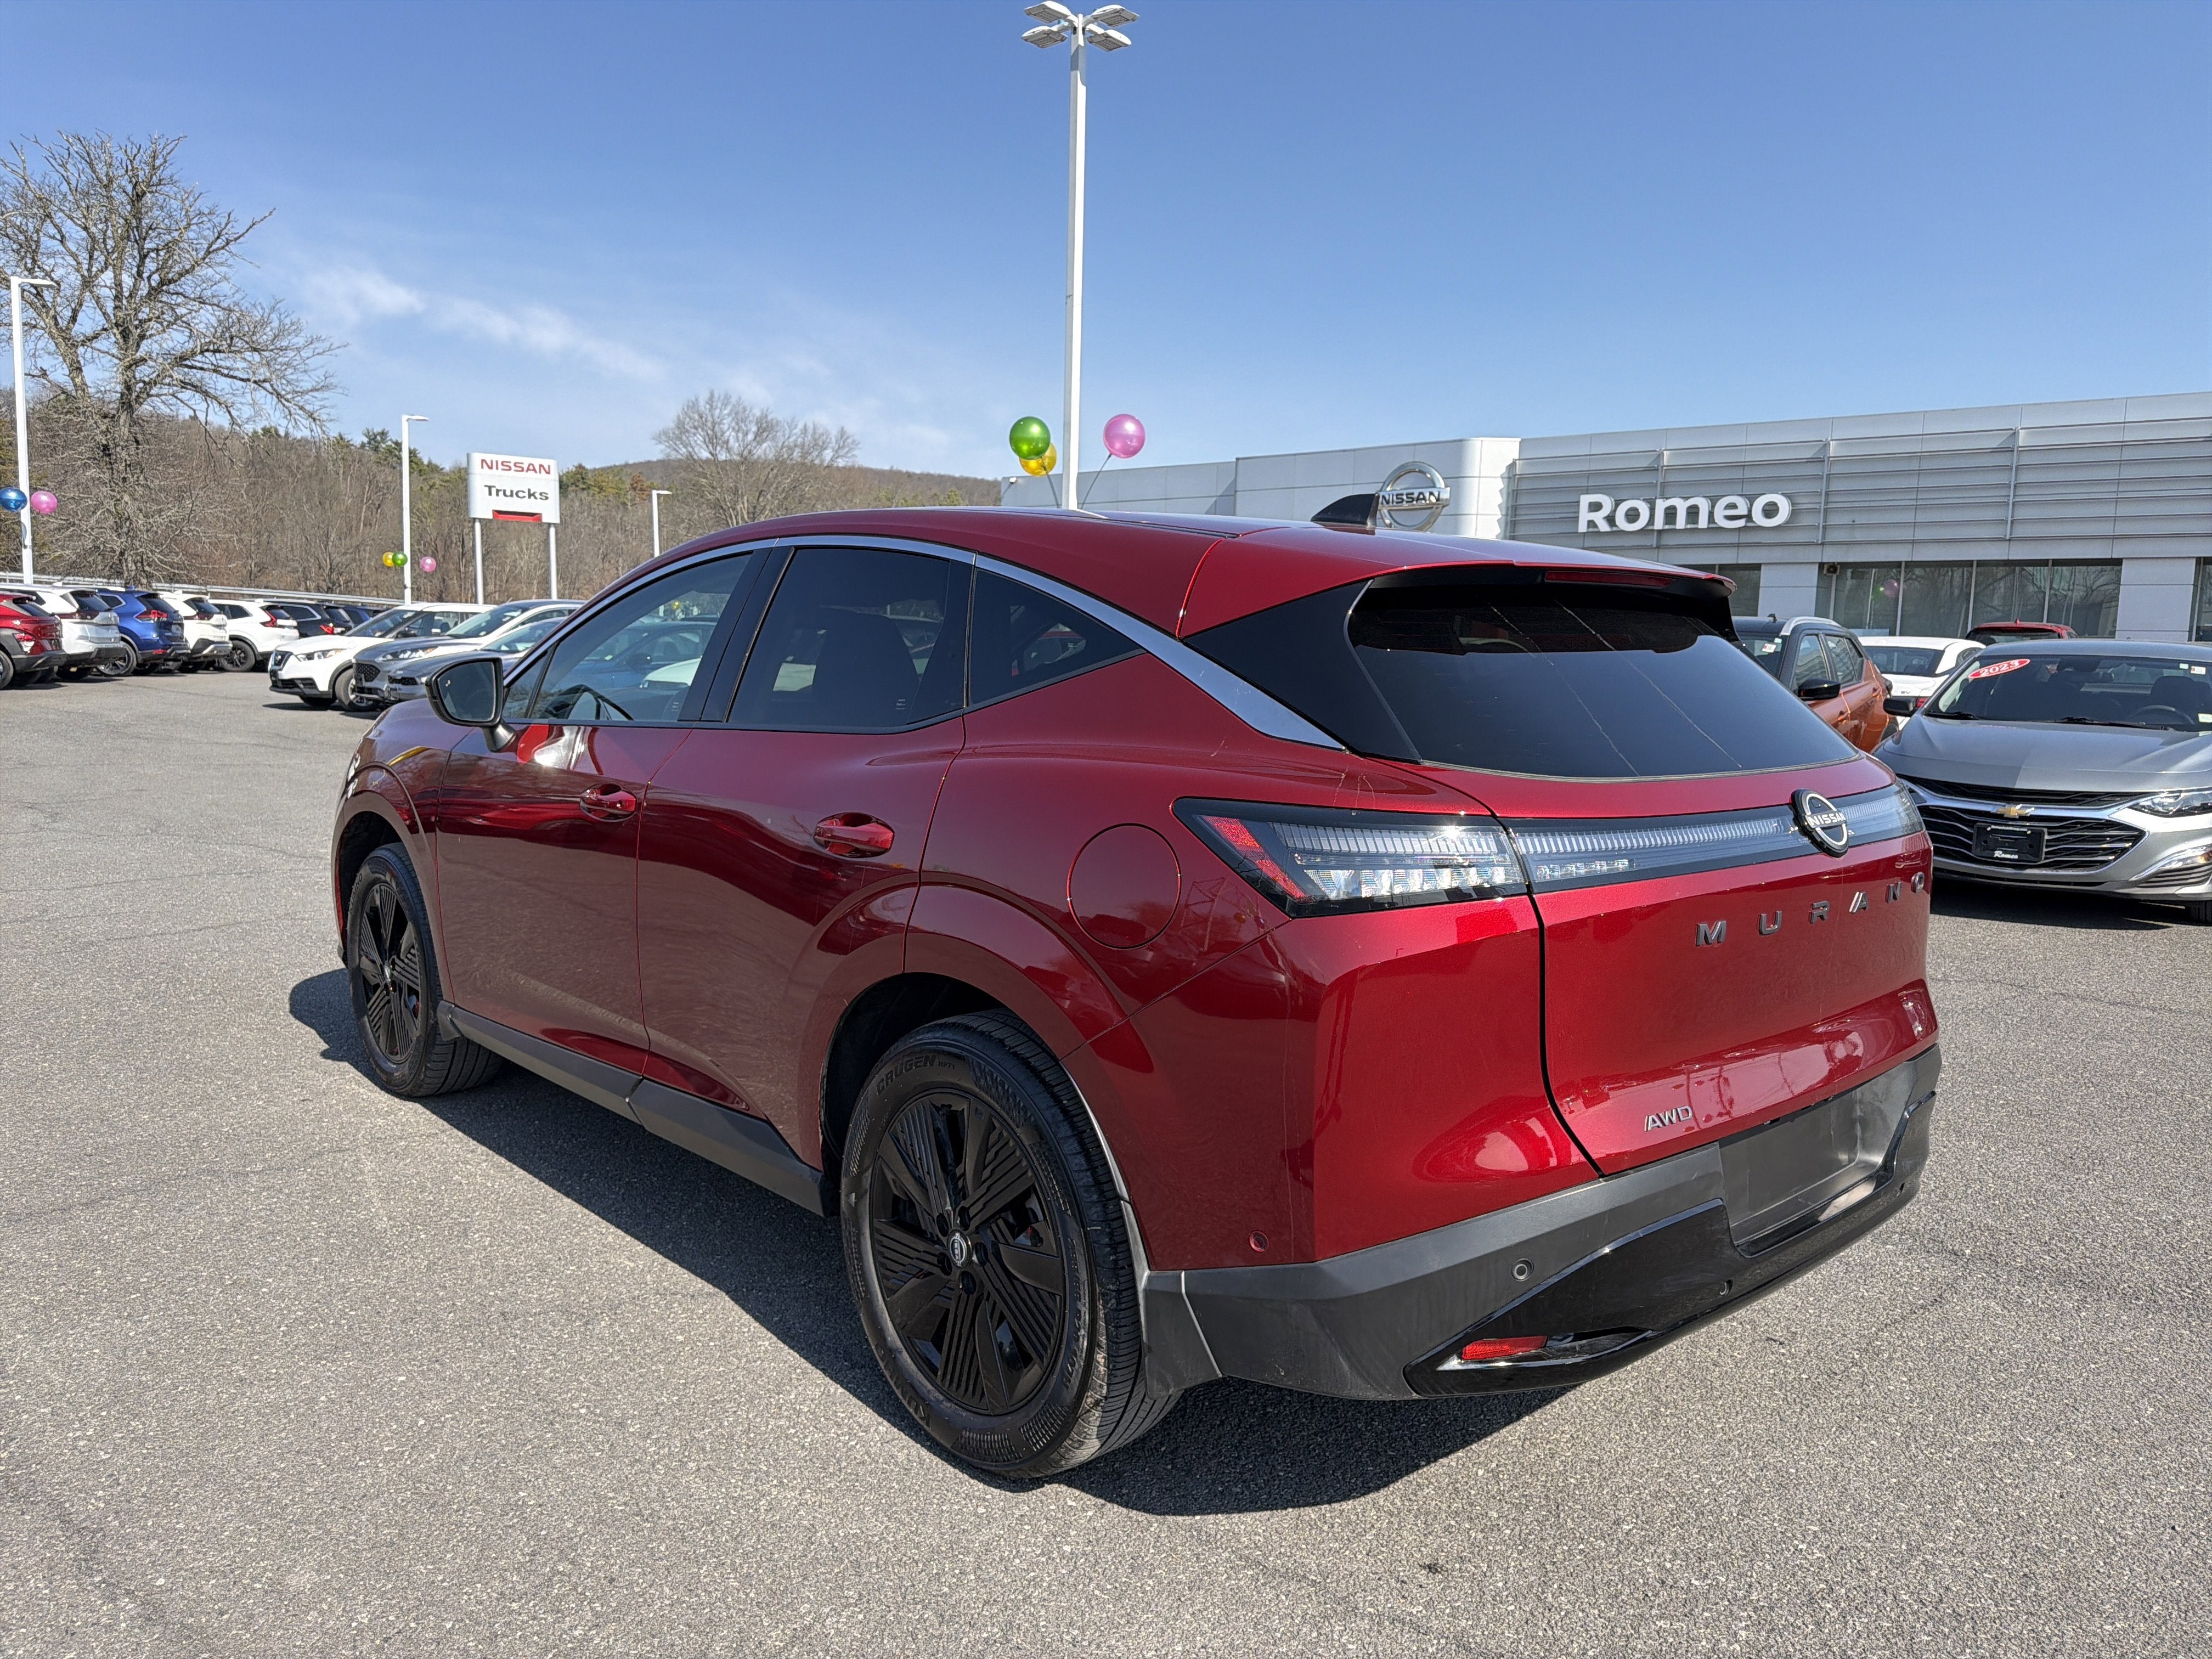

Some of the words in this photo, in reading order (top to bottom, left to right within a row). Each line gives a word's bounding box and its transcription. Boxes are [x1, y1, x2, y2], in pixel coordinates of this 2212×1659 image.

[481, 459, 551, 475] NISSAN
[484, 484, 549, 500] Trucks
[1380, 490, 1441, 505] NISSAN
[1577, 493, 1792, 533] Romeo
[1979, 661, 2019, 676] 2023
[1807, 811, 1847, 827] NISSAN
[1696, 872, 1925, 947] MURANO
[876, 1054, 936, 1096] CRUGEN
[938, 1060, 955, 1070] HP71
[1644, 1105, 1693, 1132] AWD
